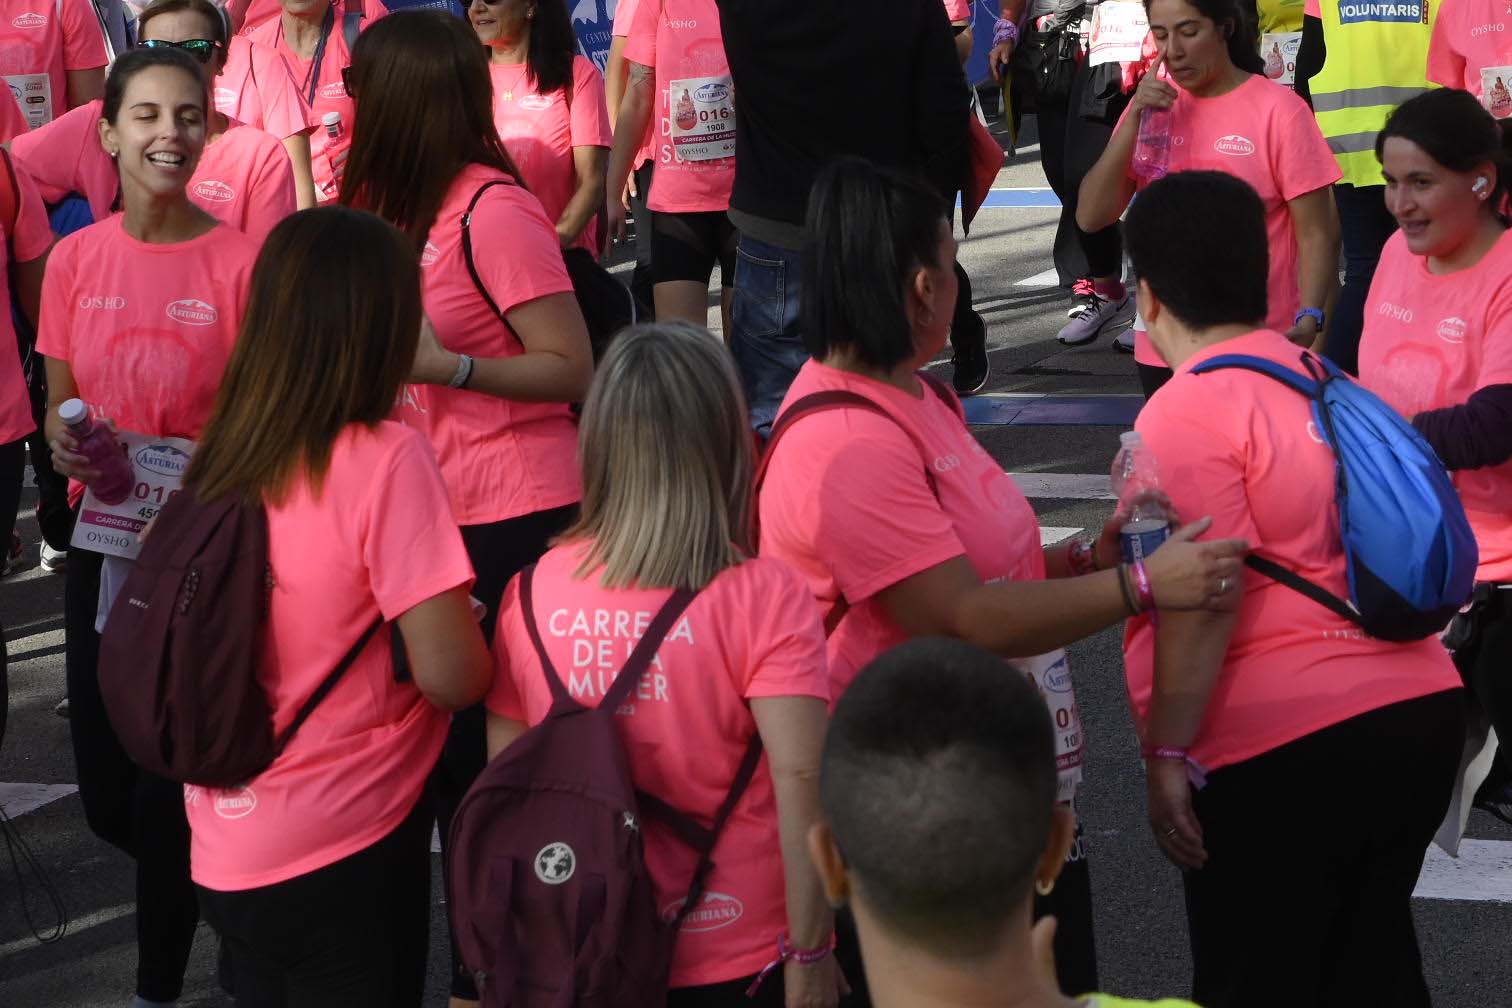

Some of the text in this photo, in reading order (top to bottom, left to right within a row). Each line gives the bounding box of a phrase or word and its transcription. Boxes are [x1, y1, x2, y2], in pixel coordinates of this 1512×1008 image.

[1339, 2, 1420, 18] VOLUNTARIS
[1471, 23, 1505, 37] OYSHO
[700, 107, 729, 122] 016
[706, 123, 725, 132] 1908
[1215, 141, 1253, 152] ASTURIANA
[168, 305, 217, 323] ASTURIANA
[96, 515, 133, 528] CARRERA
[87, 531, 129, 548] OYSHO
[572, 640, 613, 668] DE
